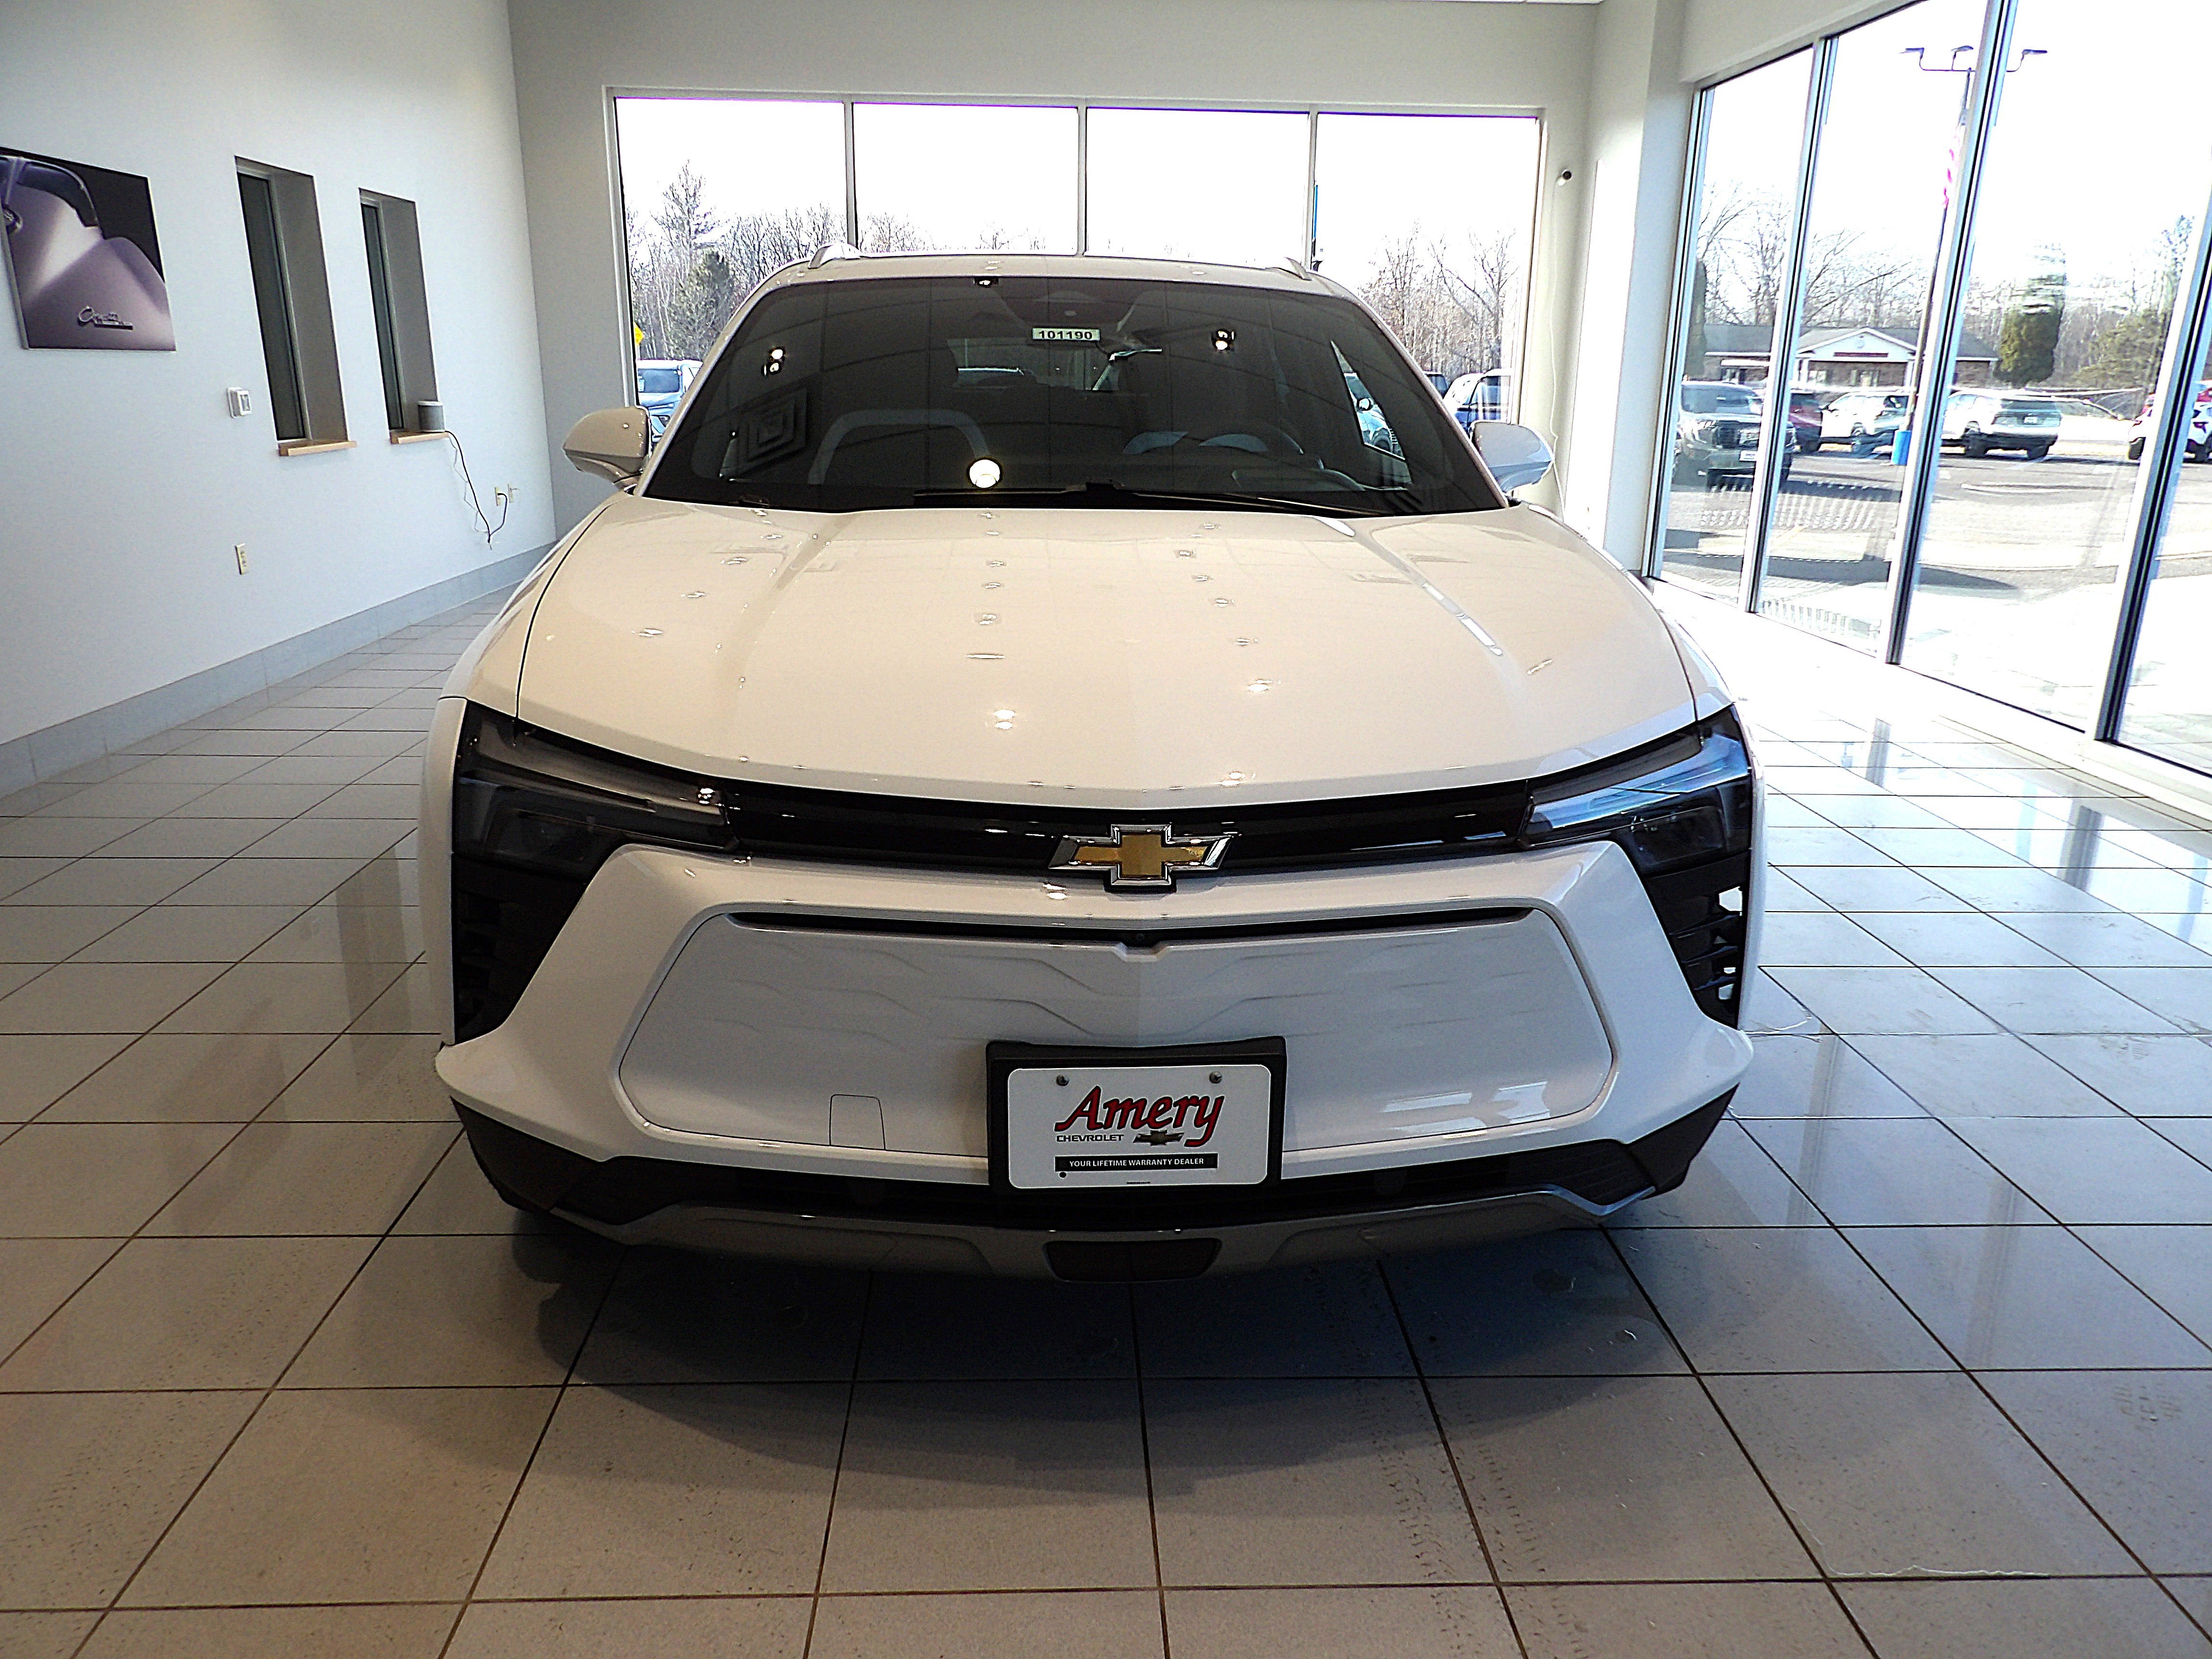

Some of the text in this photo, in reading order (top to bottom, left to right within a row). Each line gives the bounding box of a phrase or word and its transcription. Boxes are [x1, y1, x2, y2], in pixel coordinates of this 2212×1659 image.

[1039, 330, 1093, 339] 101190
[1054, 1085, 1225, 1147] Amery
[1056, 1134, 1124, 1142] CHEVROLET
